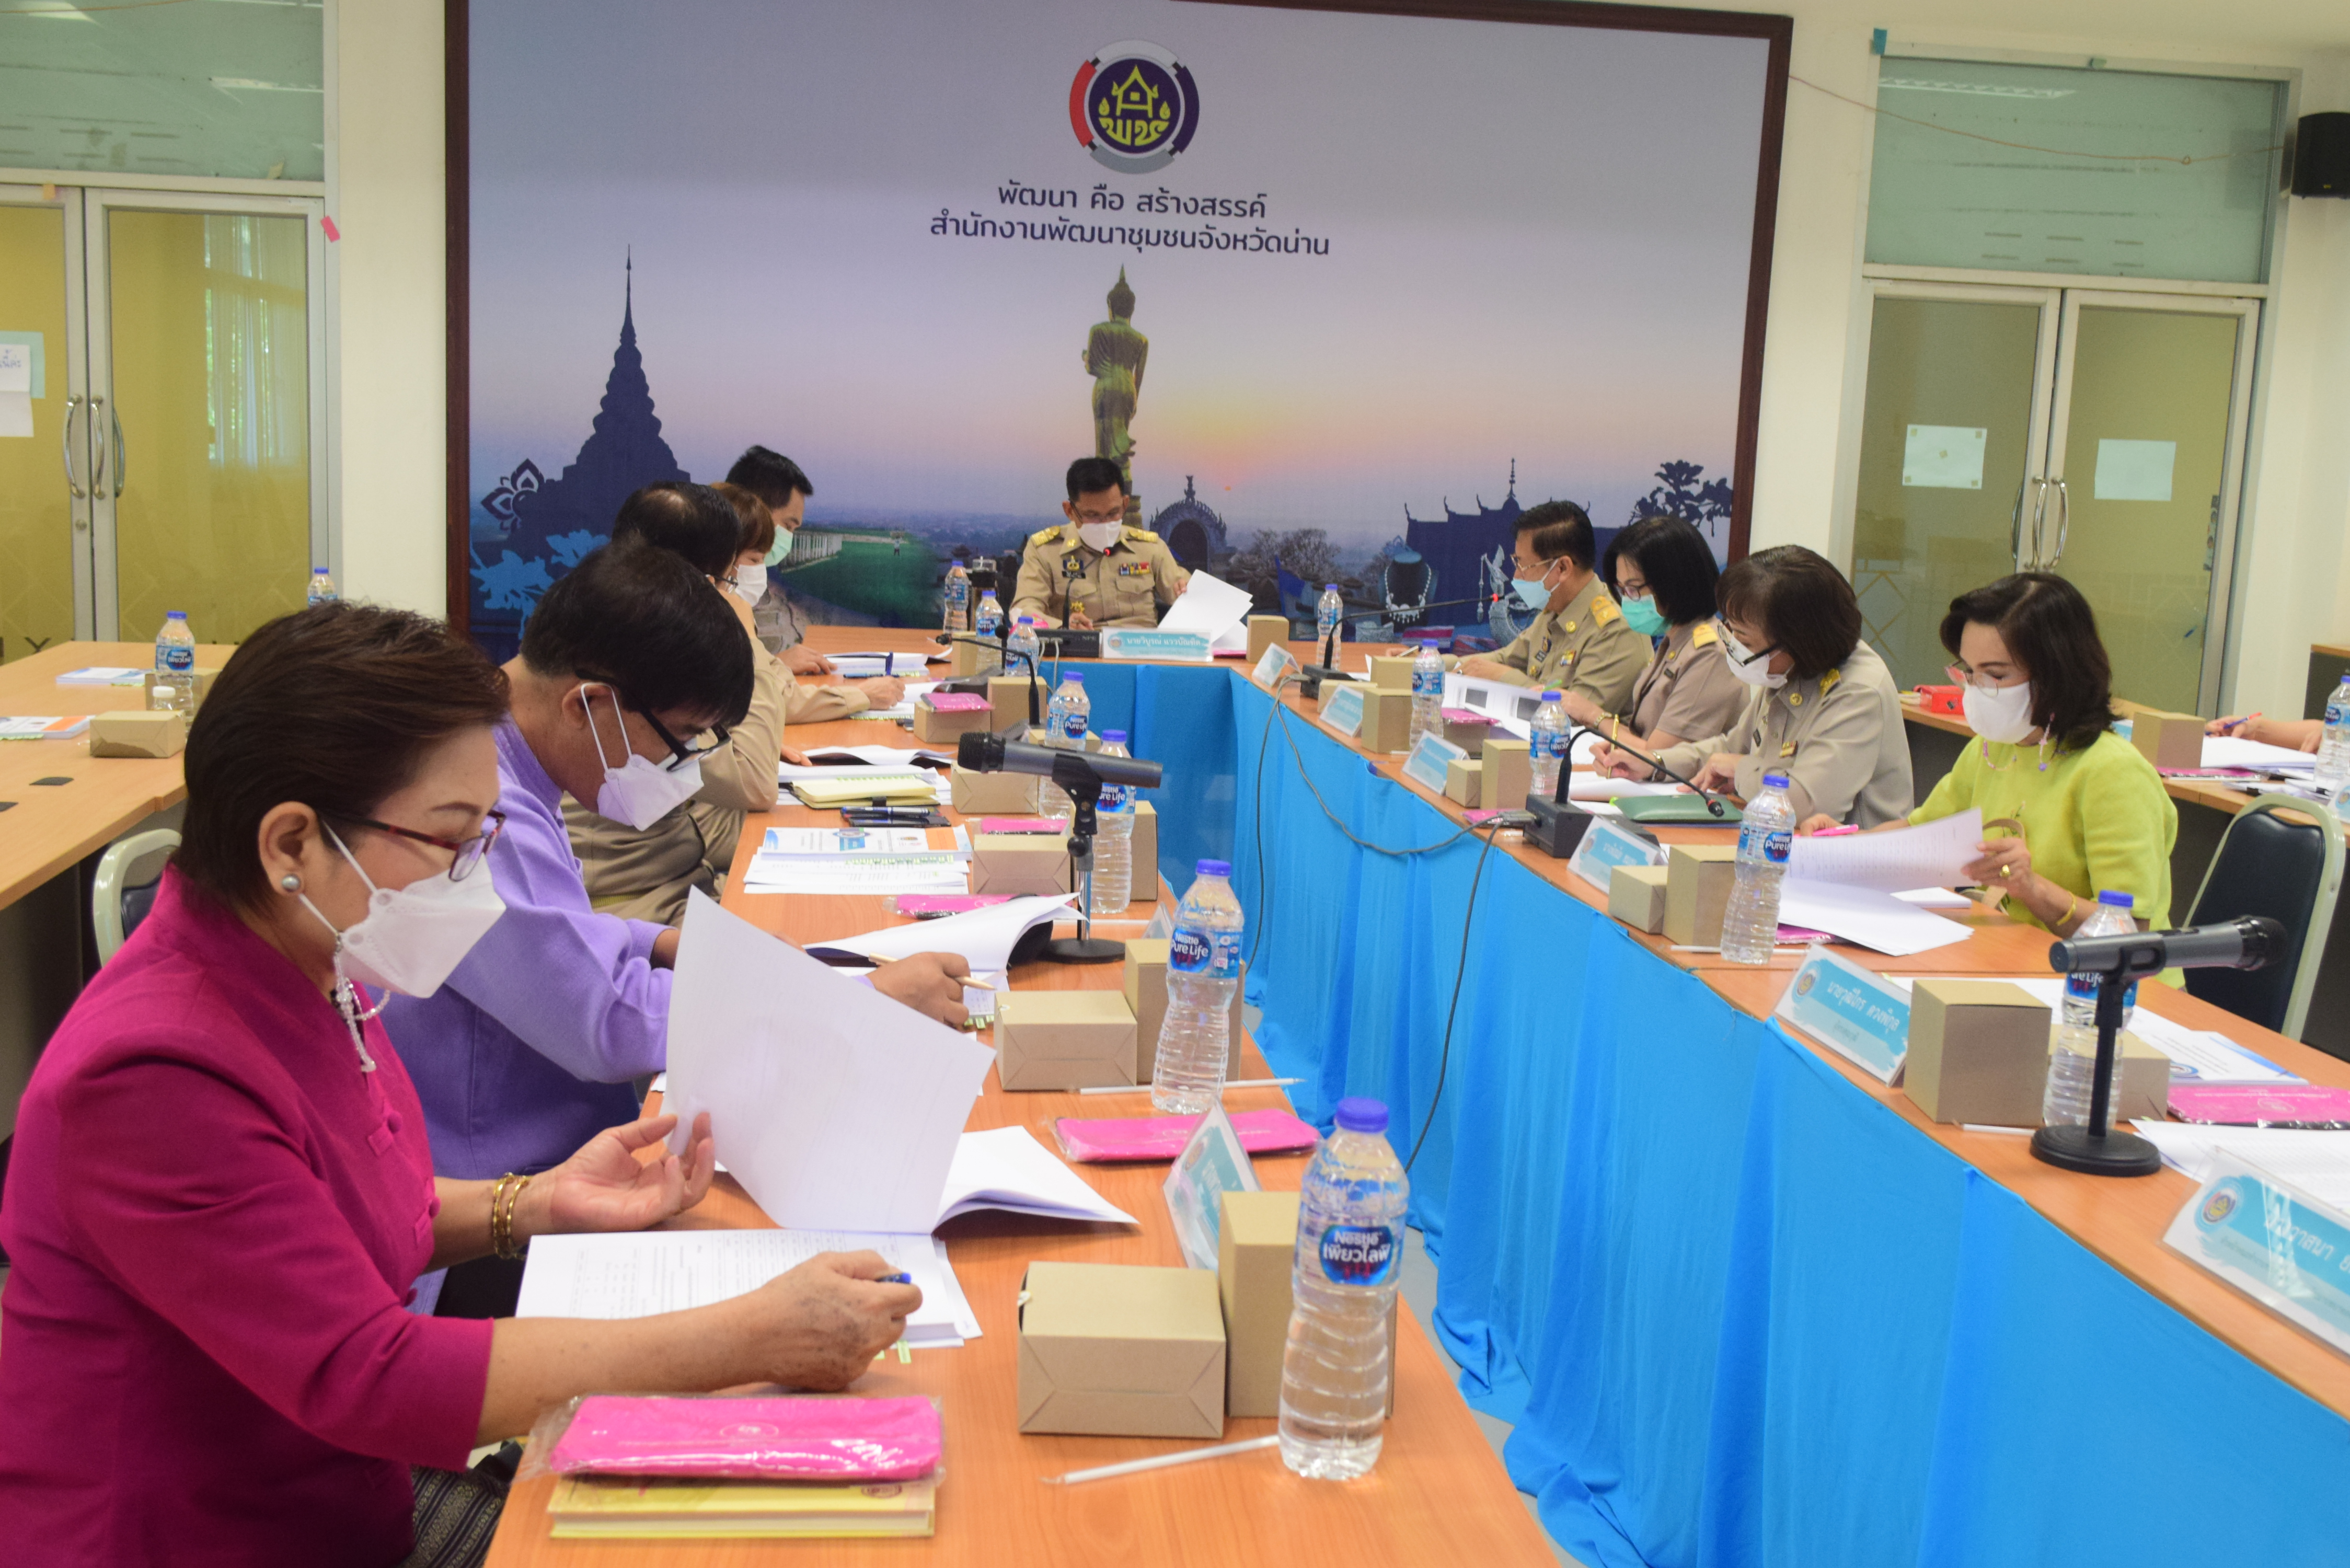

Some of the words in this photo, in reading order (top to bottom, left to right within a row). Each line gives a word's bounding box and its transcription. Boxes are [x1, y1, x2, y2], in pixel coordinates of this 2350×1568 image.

[998, 179, 1077, 207] พัฒนา
[1091, 183, 1124, 211] คือ
[1136, 187, 1267, 218] สร้างสรรค์
[930, 209, 1329, 255] สำนักงานพัฒนาชุมชนจังหวัดน่าน
[1099, 792, 1112, 801] ure
[1112, 792, 1125, 804] Life
[1765, 839, 1785, 851] Pure
[1171, 939, 1189, 954] Pure
[1189, 946, 1208, 960] Life
